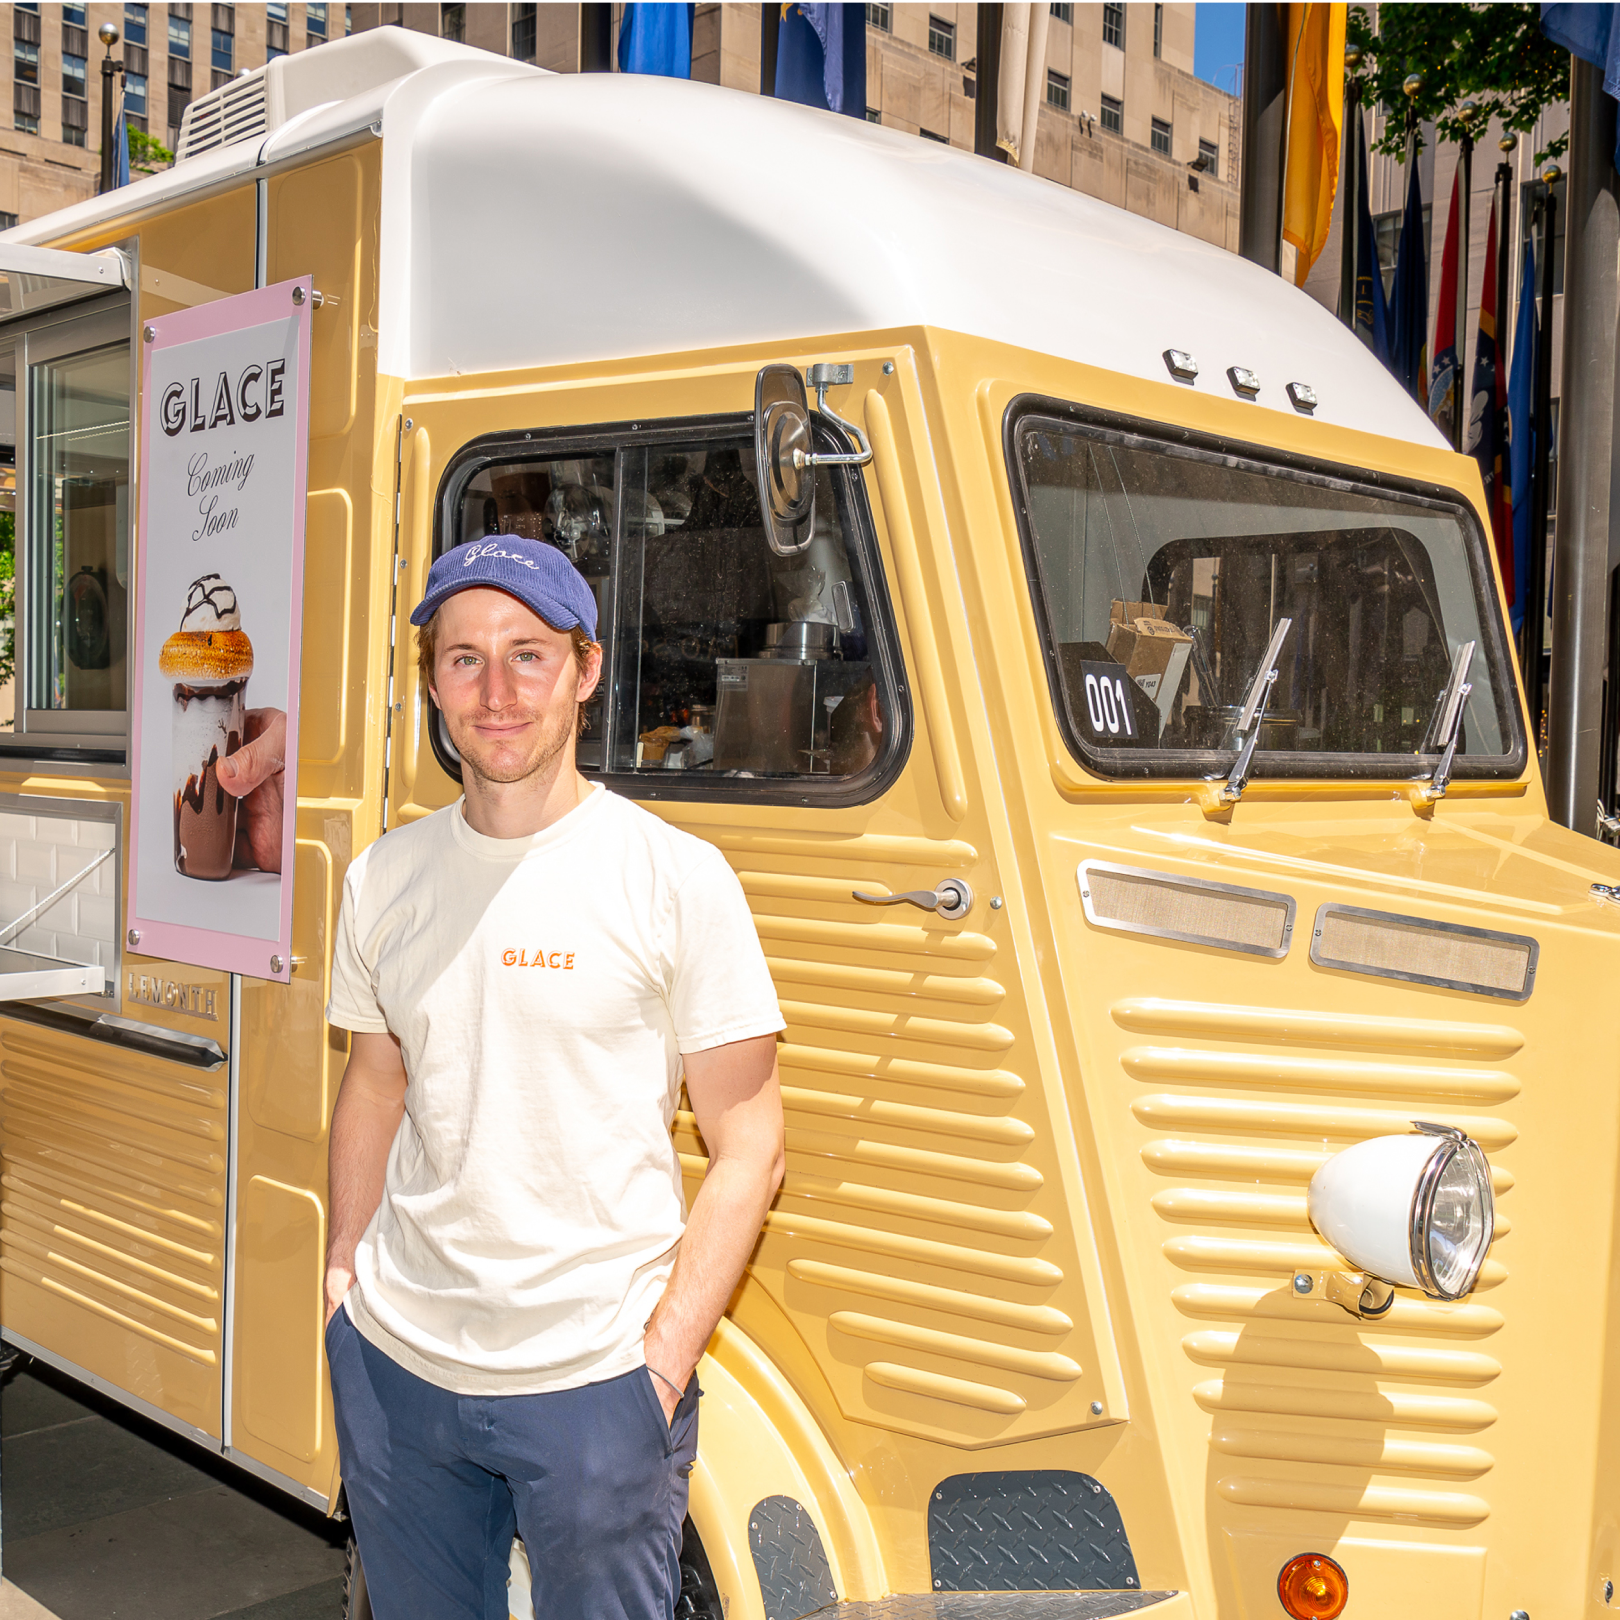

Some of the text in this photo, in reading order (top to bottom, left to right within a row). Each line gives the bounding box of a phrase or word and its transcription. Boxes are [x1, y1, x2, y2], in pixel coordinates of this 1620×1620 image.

[160, 358, 286, 437] GLACE
[187, 450, 255, 497] Coming
[192, 494, 239, 542] Soon
[464, 543, 540, 570] Glace
[1085, 674, 1132, 736] 001
[500, 947, 576, 970] GLACE
[128, 972, 219, 1022] LEMONTH
